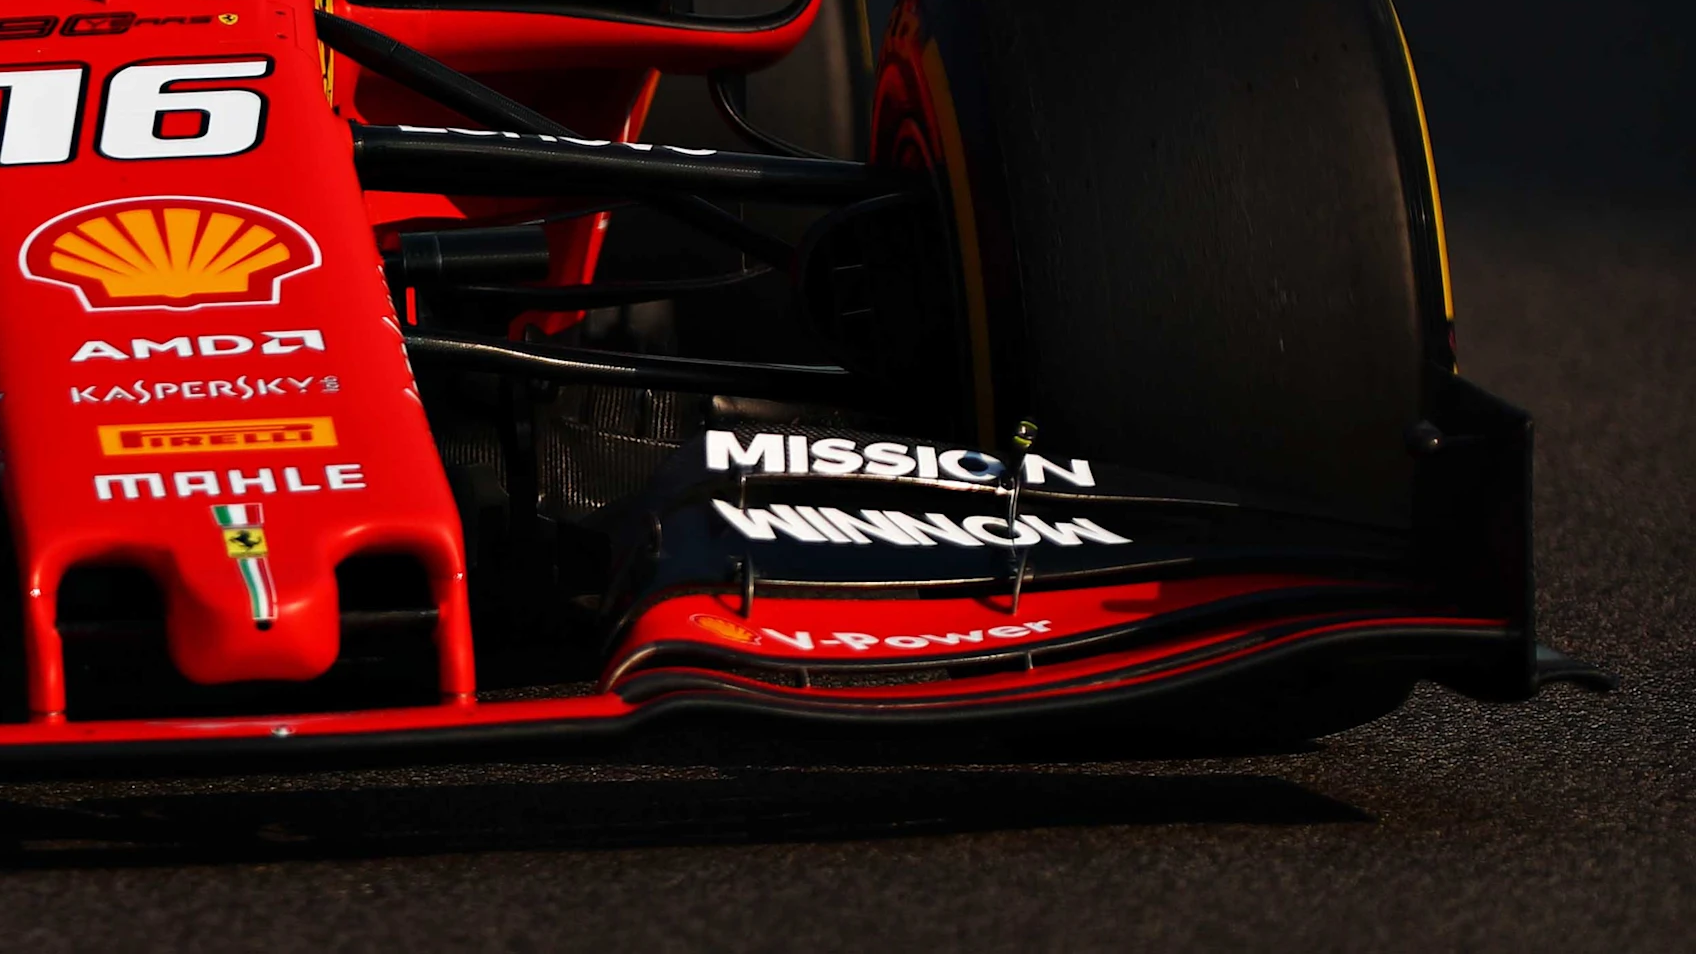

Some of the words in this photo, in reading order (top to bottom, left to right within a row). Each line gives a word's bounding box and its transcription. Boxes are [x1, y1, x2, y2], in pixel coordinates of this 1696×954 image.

[70, 334, 254, 363] AMD
[71, 376, 314, 404] KASPERSKY
[119, 422, 314, 449] PIRELLI
[705, 430, 1096, 488] MISSION
[94, 464, 366, 500] MAHLE
[711, 498, 1134, 547] WINNOW
[761, 619, 1053, 651] V-Power
